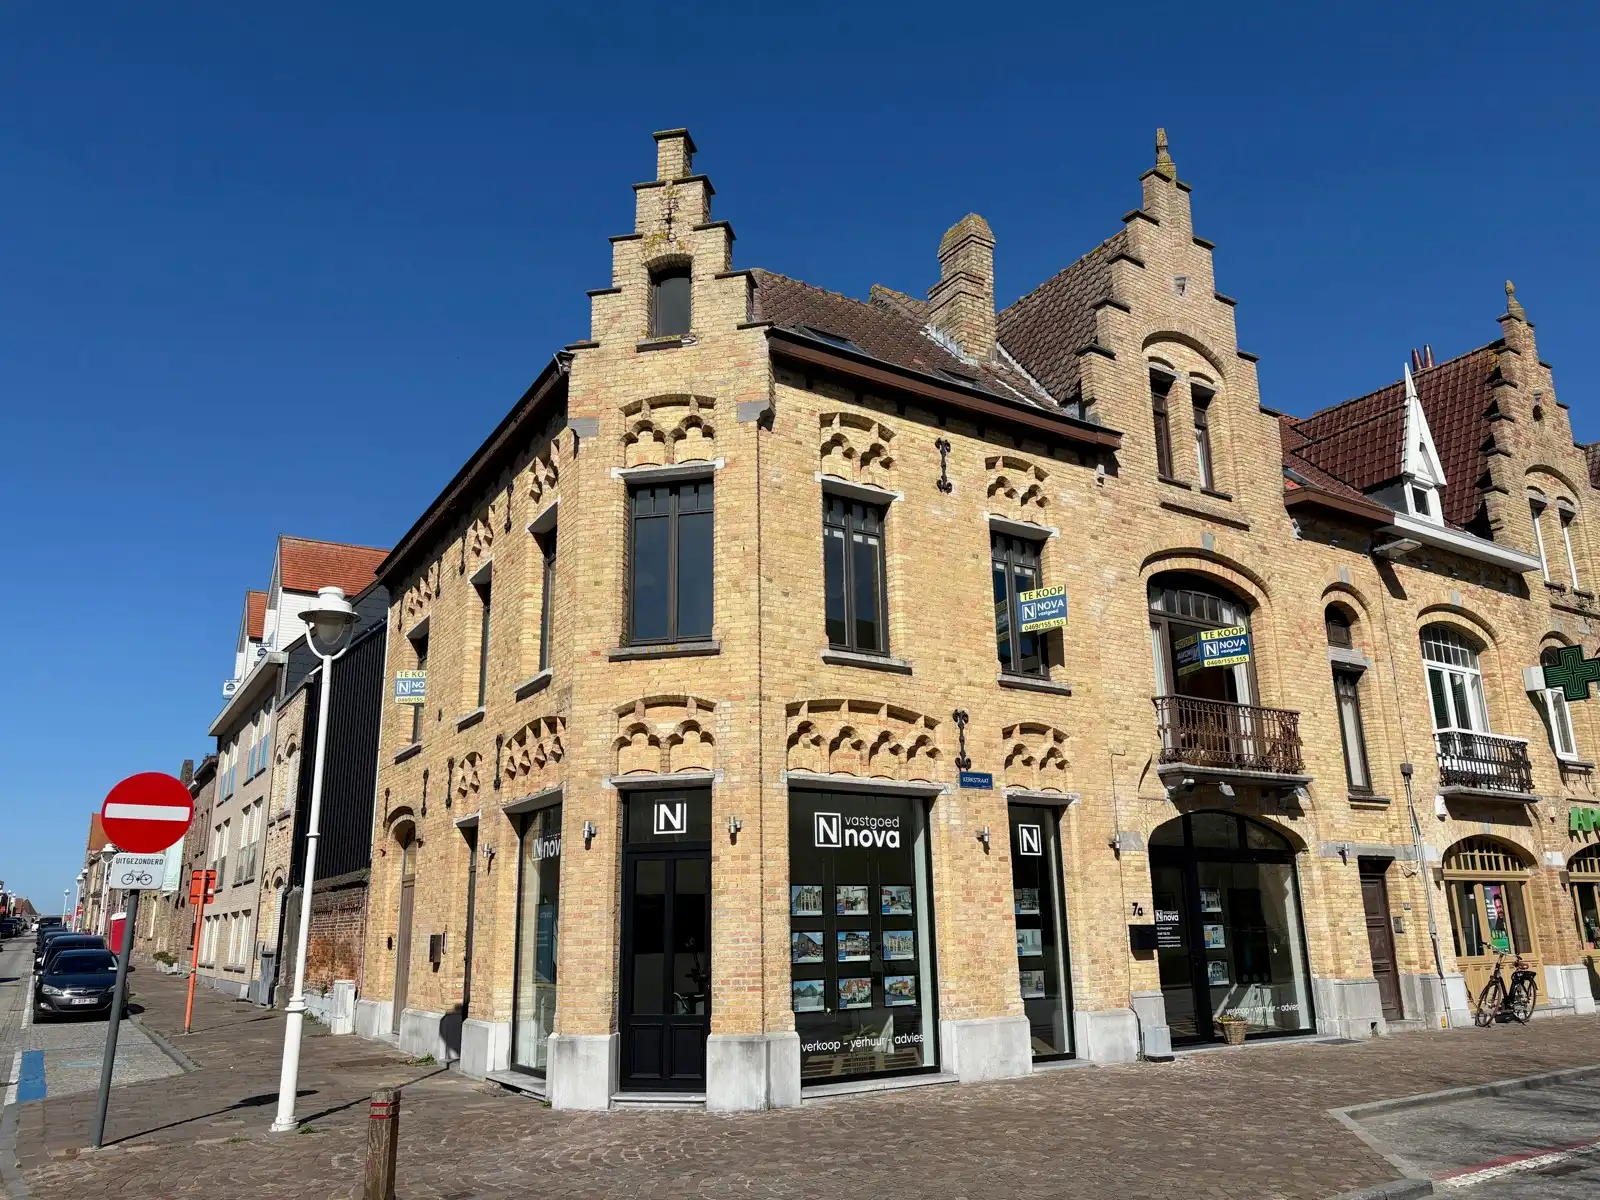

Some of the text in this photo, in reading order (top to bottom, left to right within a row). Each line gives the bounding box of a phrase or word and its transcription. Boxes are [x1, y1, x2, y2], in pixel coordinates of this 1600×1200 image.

[1022, 586, 1063, 600] TE KOOP
[1023, 604, 1035, 619] N
[1037, 599, 1064, 611] NOVA
[1217, 627, 1245, 637] KOOP
[1205, 639, 1247, 656] N NOVA
[399, 681, 409, 693] N
[962, 776, 989, 784] KERKSTRAAT
[658, 803, 682, 830] N
[844, 815, 900, 829] vastgoed
[818, 816, 900, 849] N nova
[1022, 828, 1039, 852] N
[115, 857, 164, 866] UITGEZONDERD
[1132, 902, 1143, 917] 7a
[801, 1040, 841, 1053] verkoop
[850, 1037, 886, 1049] verhuur
[894, 1032, 924, 1045] advies
